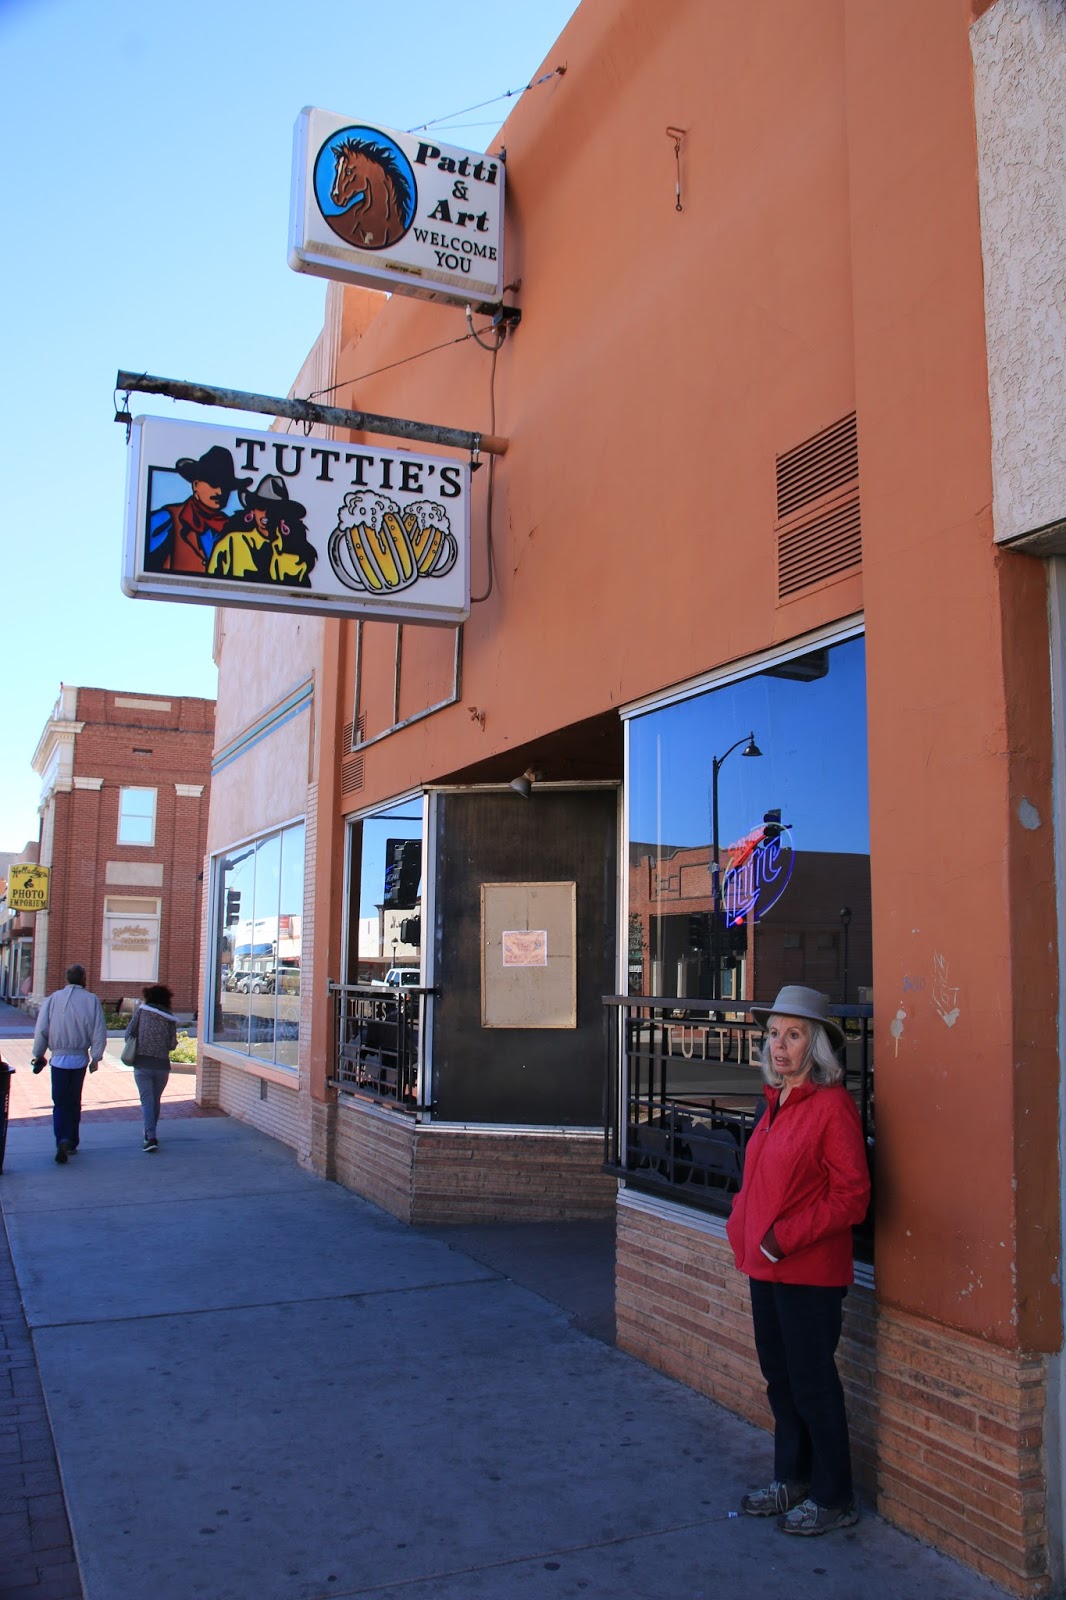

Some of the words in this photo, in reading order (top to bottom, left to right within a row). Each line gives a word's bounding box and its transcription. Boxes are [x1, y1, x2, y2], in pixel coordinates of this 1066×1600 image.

[413, 141, 498, 185] Patti
[452, 180, 469, 201] &
[427, 199, 489, 232] Art
[413, 227, 497, 261] WELCOME
[434, 250, 472, 273] YOU
[235, 437, 462, 498] TUTTIE'S
[10, 898, 46, 907] EMPORIUM
[12, 889, 44, 899] PHOTO
